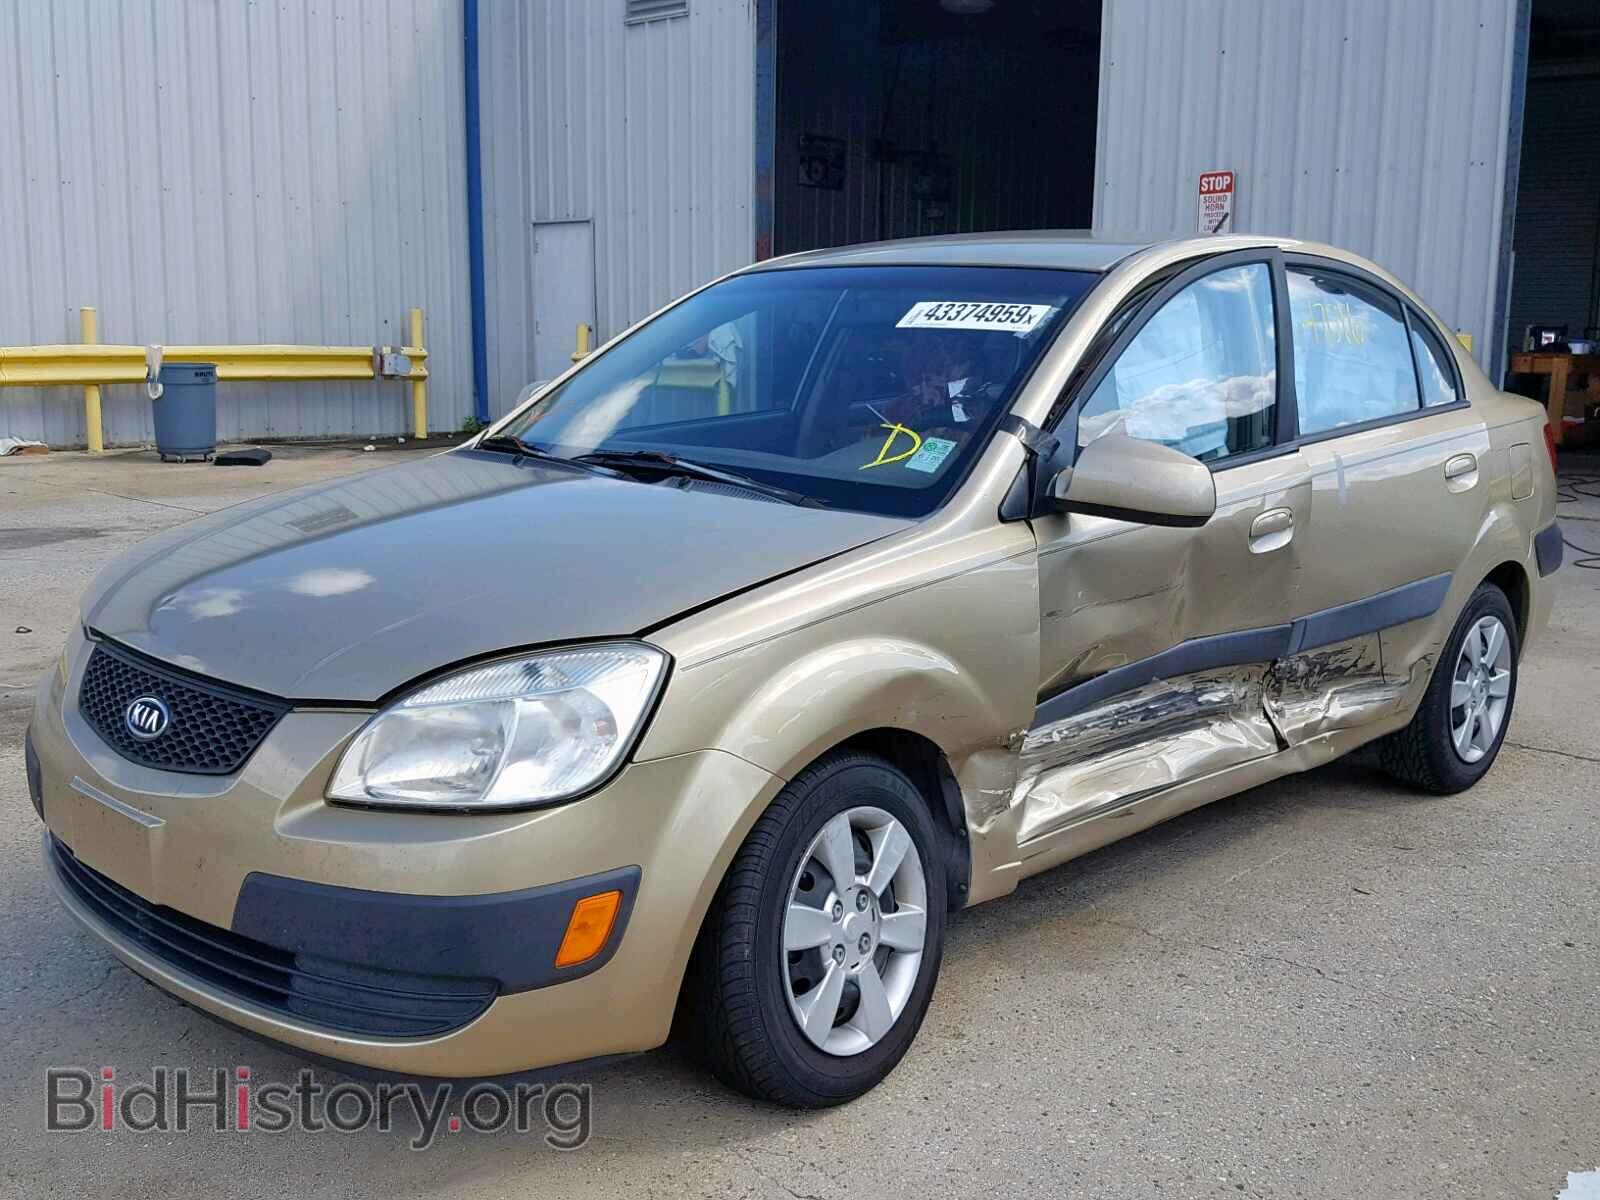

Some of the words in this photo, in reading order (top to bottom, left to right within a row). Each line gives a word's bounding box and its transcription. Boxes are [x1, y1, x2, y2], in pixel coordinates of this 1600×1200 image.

[1200, 175, 1231, 191] STOP
[859, 423, 922, 470] D
[131, 703, 160, 732] KIA
